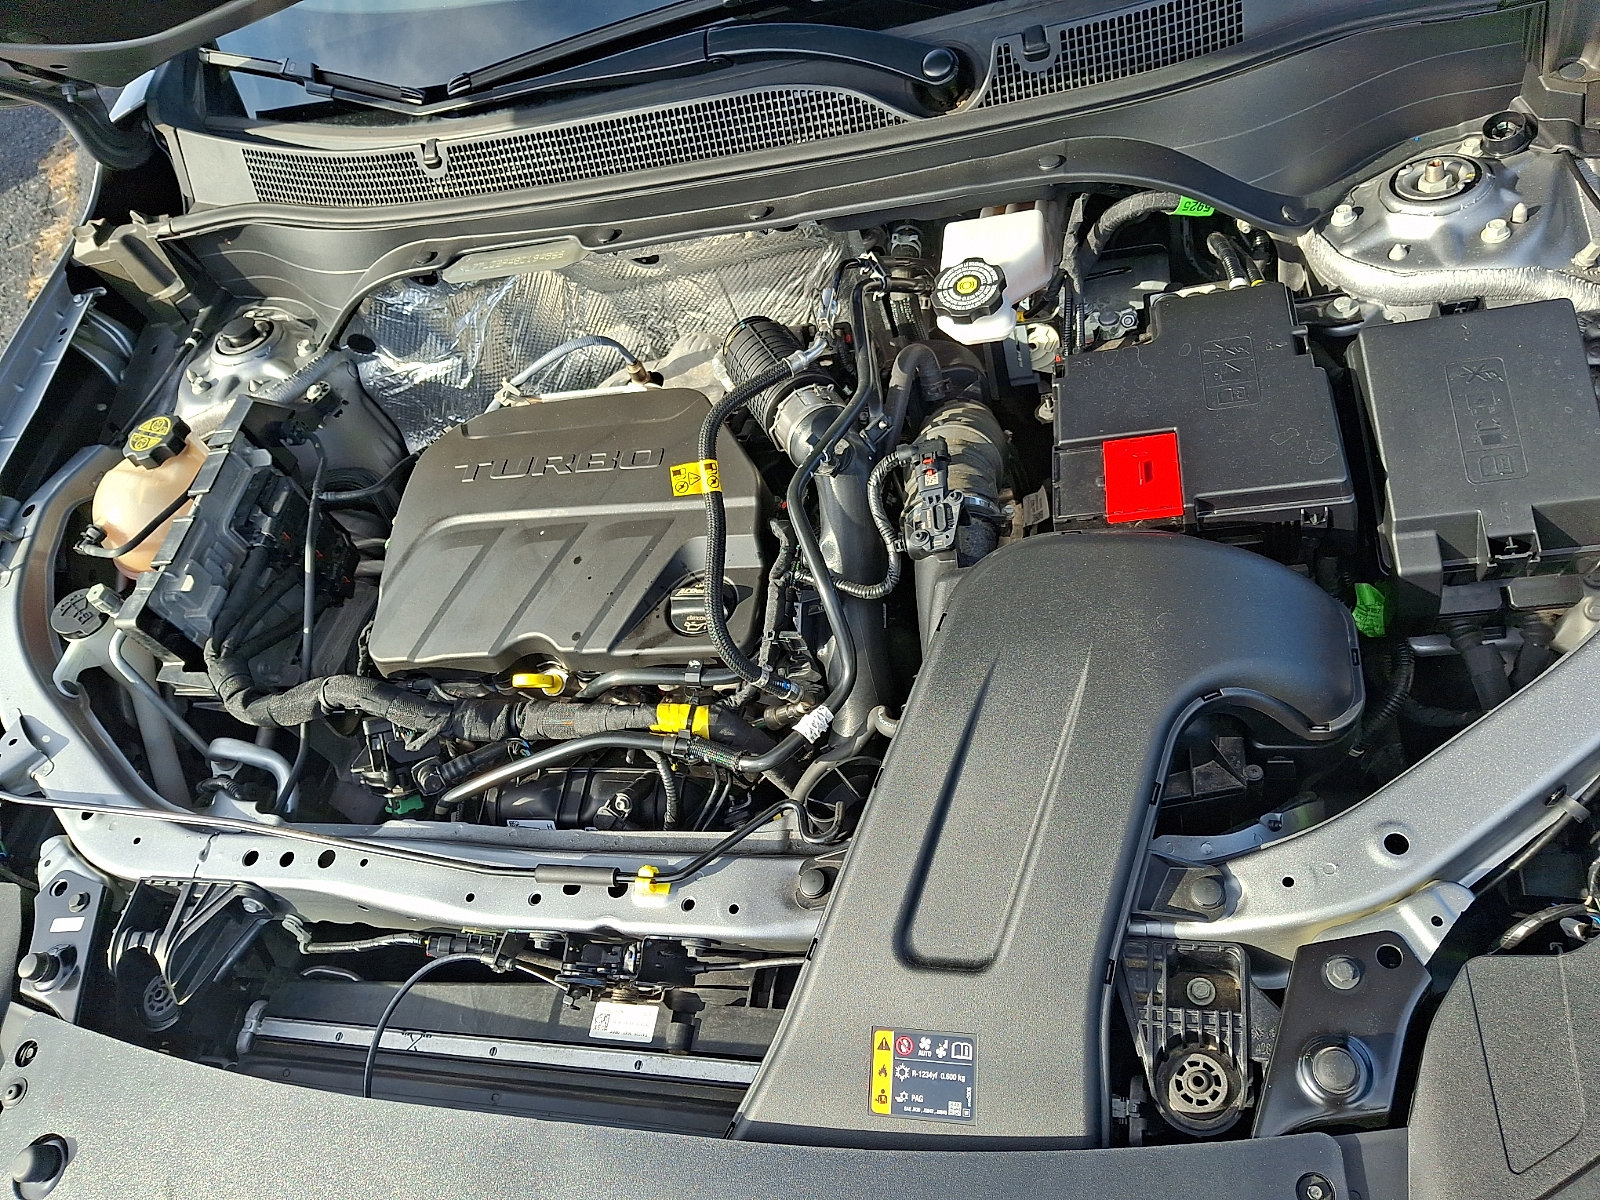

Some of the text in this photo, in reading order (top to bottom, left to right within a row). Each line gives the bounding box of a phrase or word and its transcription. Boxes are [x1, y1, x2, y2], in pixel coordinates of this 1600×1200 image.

[455, 448, 665, 483] TURBO
[912, 1070, 938, 1081] R-1234yf
[957, 1074, 966, 1083] kg
[911, 1094, 924, 1102] PAG
